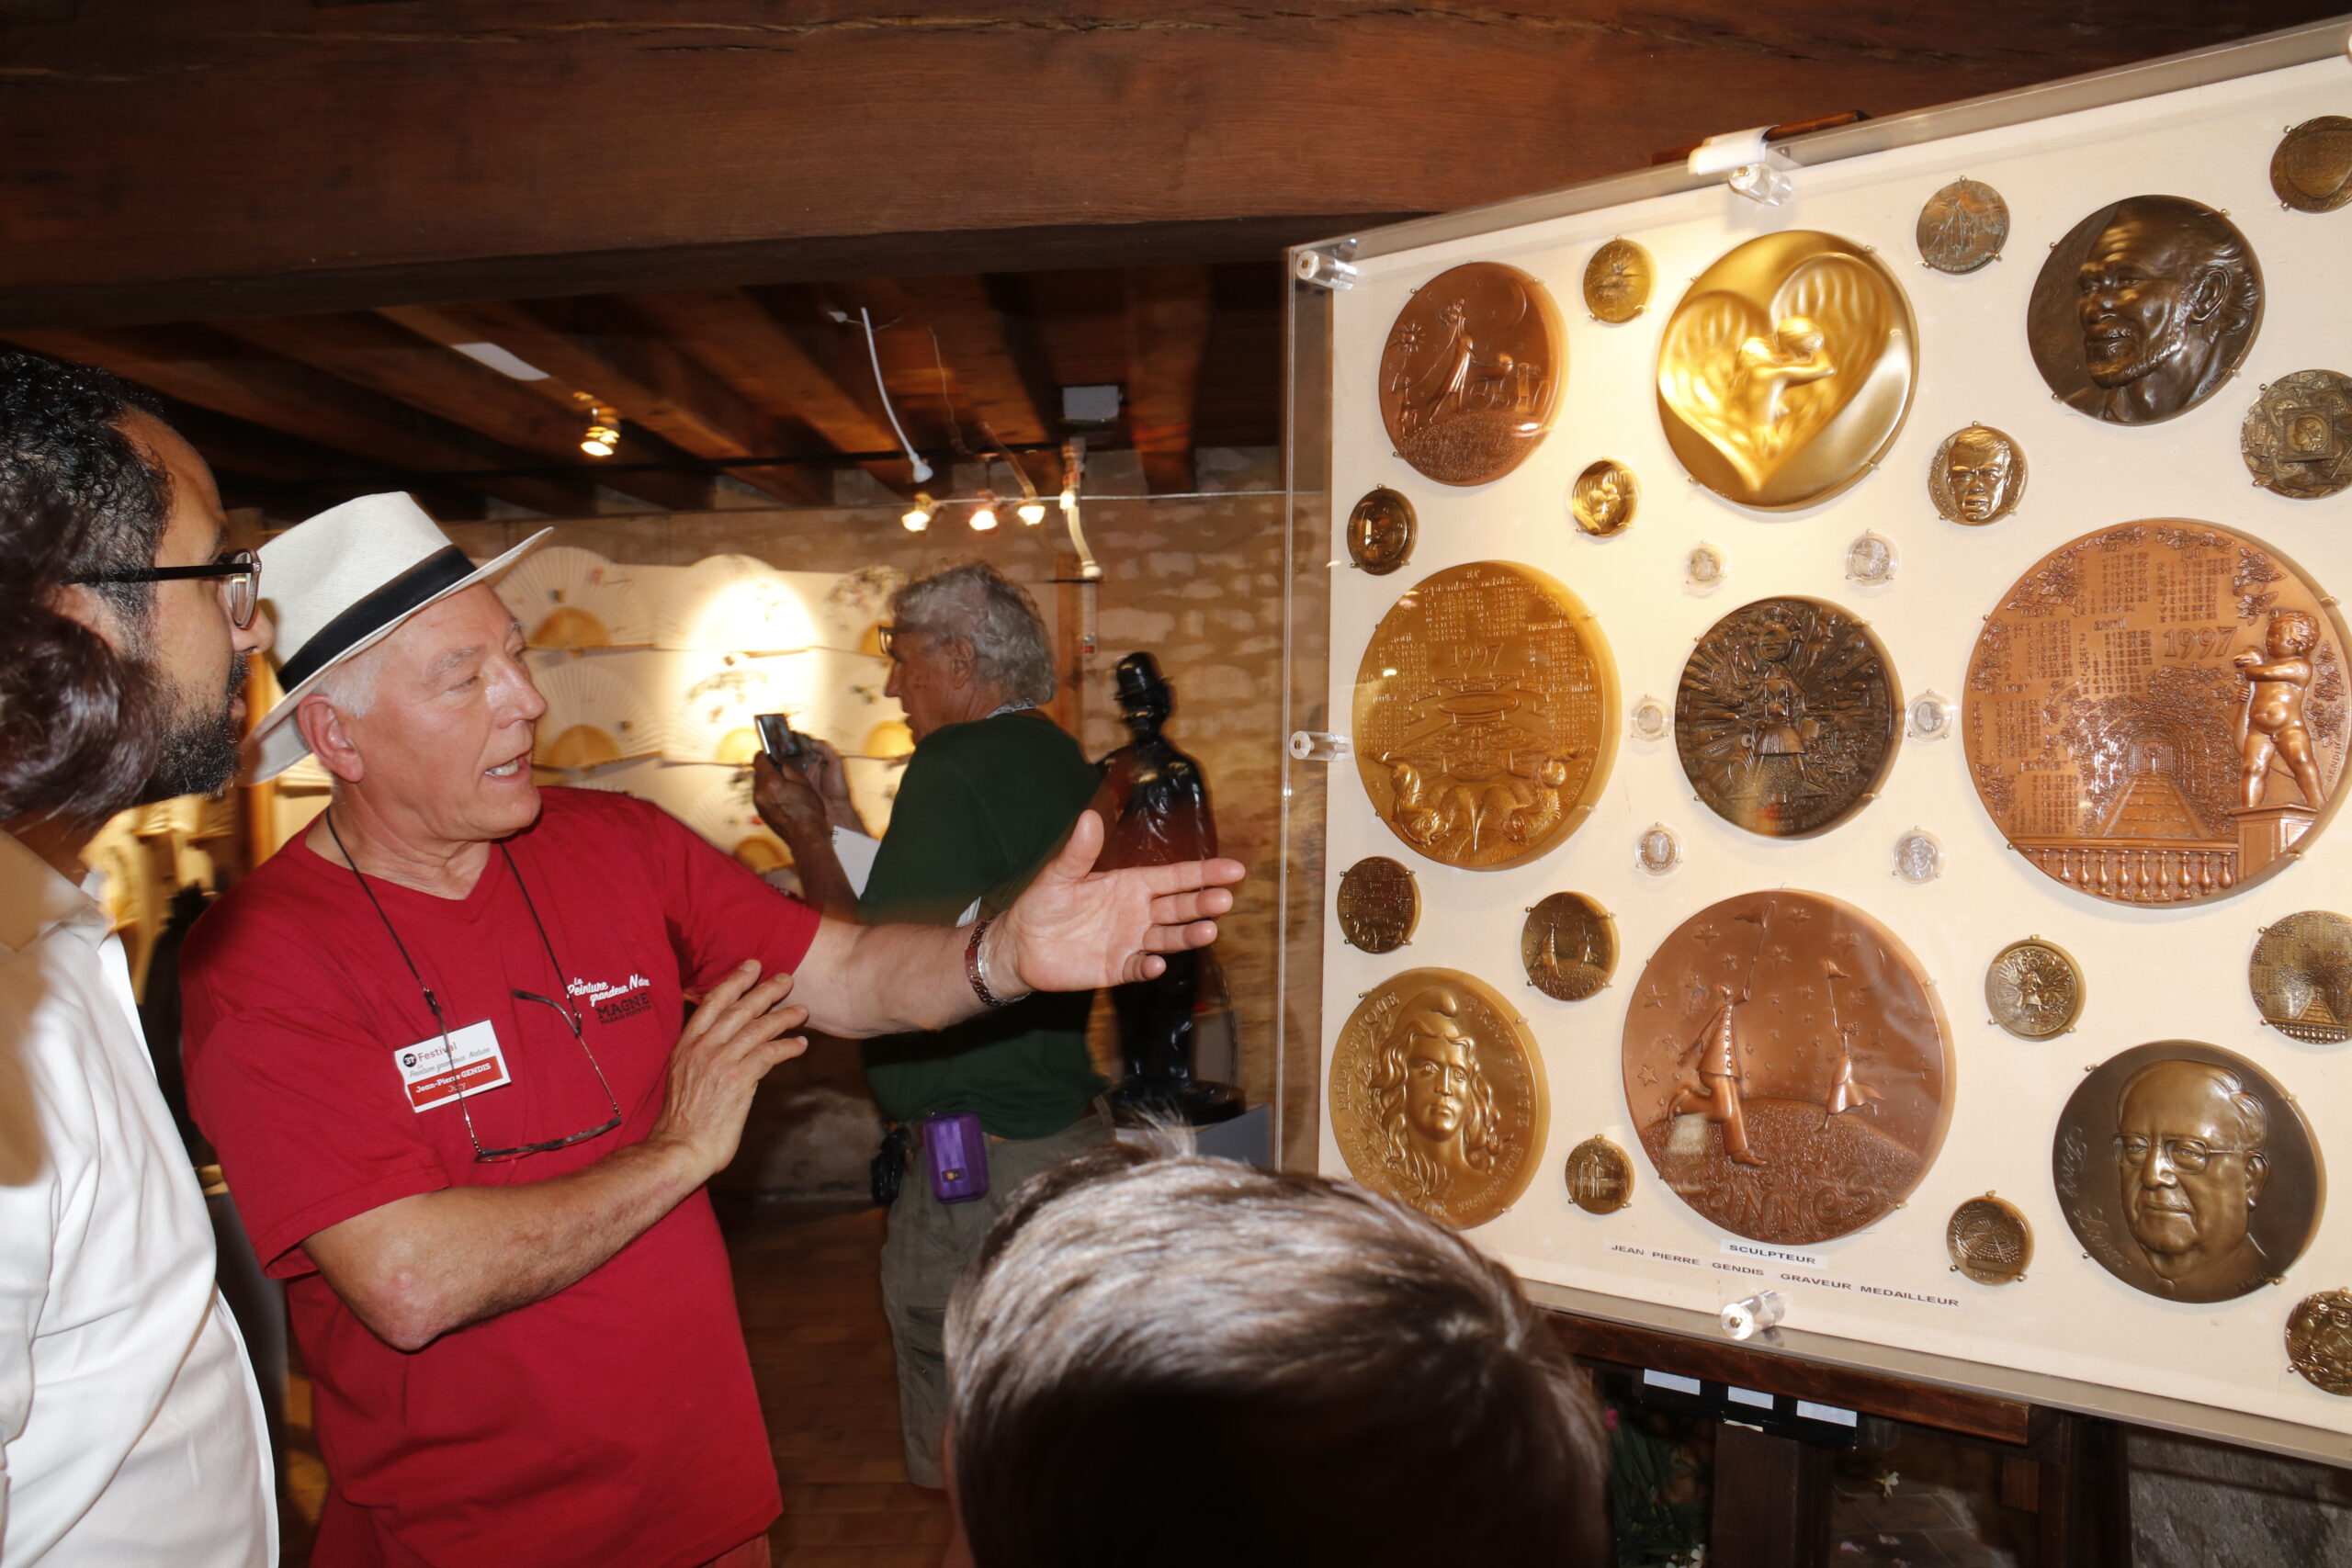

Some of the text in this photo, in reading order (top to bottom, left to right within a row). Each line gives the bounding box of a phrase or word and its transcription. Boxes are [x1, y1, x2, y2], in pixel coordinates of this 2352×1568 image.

[2162, 626, 2241, 660] 1997
[1450, 641, 1504, 671] 1997
[418, 1042, 458, 1061] Festival
[461, 1063, 492, 1077] GENDIS
[1729, 1245, 1816, 1265] SCULPTEUR
[1611, 1245, 1959, 1306] JEAN PIERRE GENDIS GRAVEUR MEDAILLEUR
